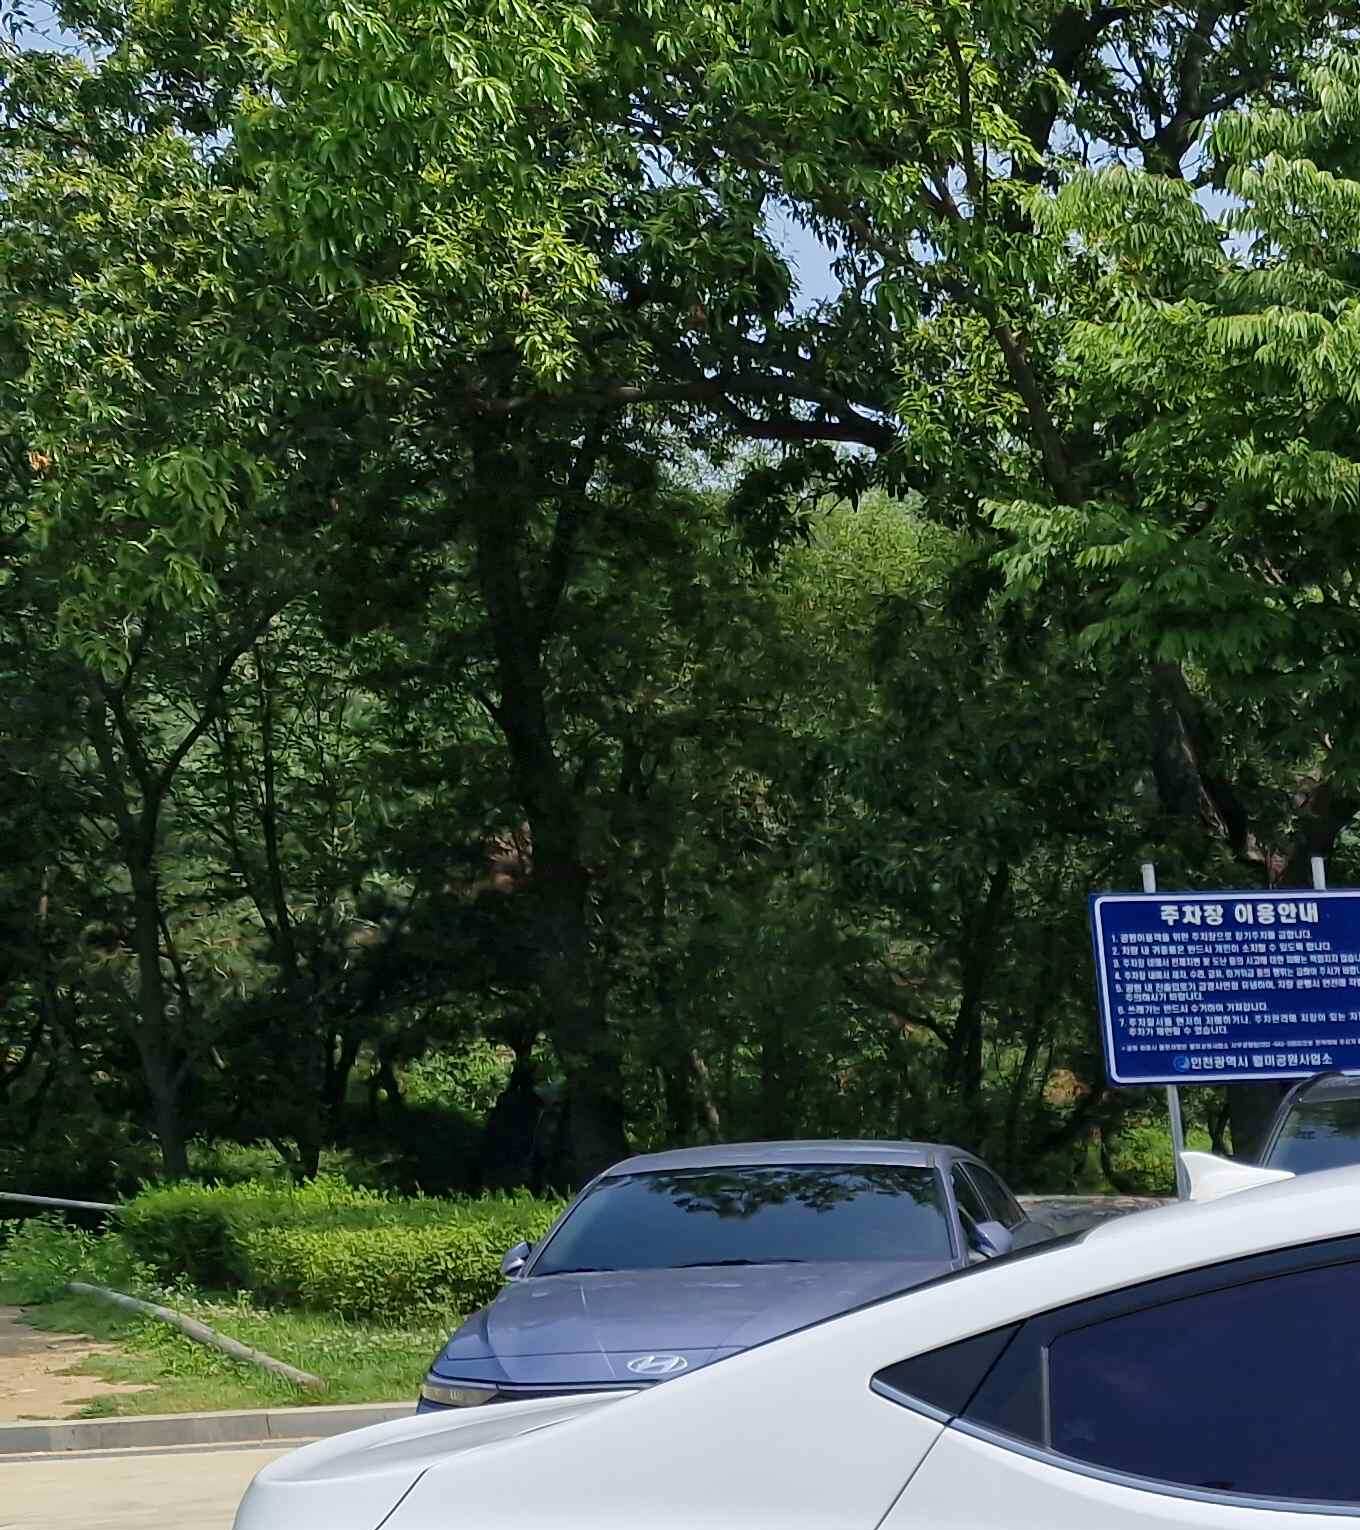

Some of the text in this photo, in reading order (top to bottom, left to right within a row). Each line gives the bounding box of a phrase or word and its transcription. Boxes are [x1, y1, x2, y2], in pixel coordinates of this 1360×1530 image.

[1160, 902, 1318, 926] 주차장 이용안내
[1172, 932, 1189, 942] 위한
[1191, 931, 1232, 942] 주차장으로
[1187, 945, 1213, 955] 반드시
[1269, 943, 1277, 952] 수
[1212, 957, 1227, 966] 도난
[1127, 1005, 1161, 1015] 쓰레기는
[1163, 1004, 1189, 1014] 반드시
[1183, 1026, 1192, 1036] 수
[1190, 1053, 1333, 1070] 인천광역시 월미공원사업소
